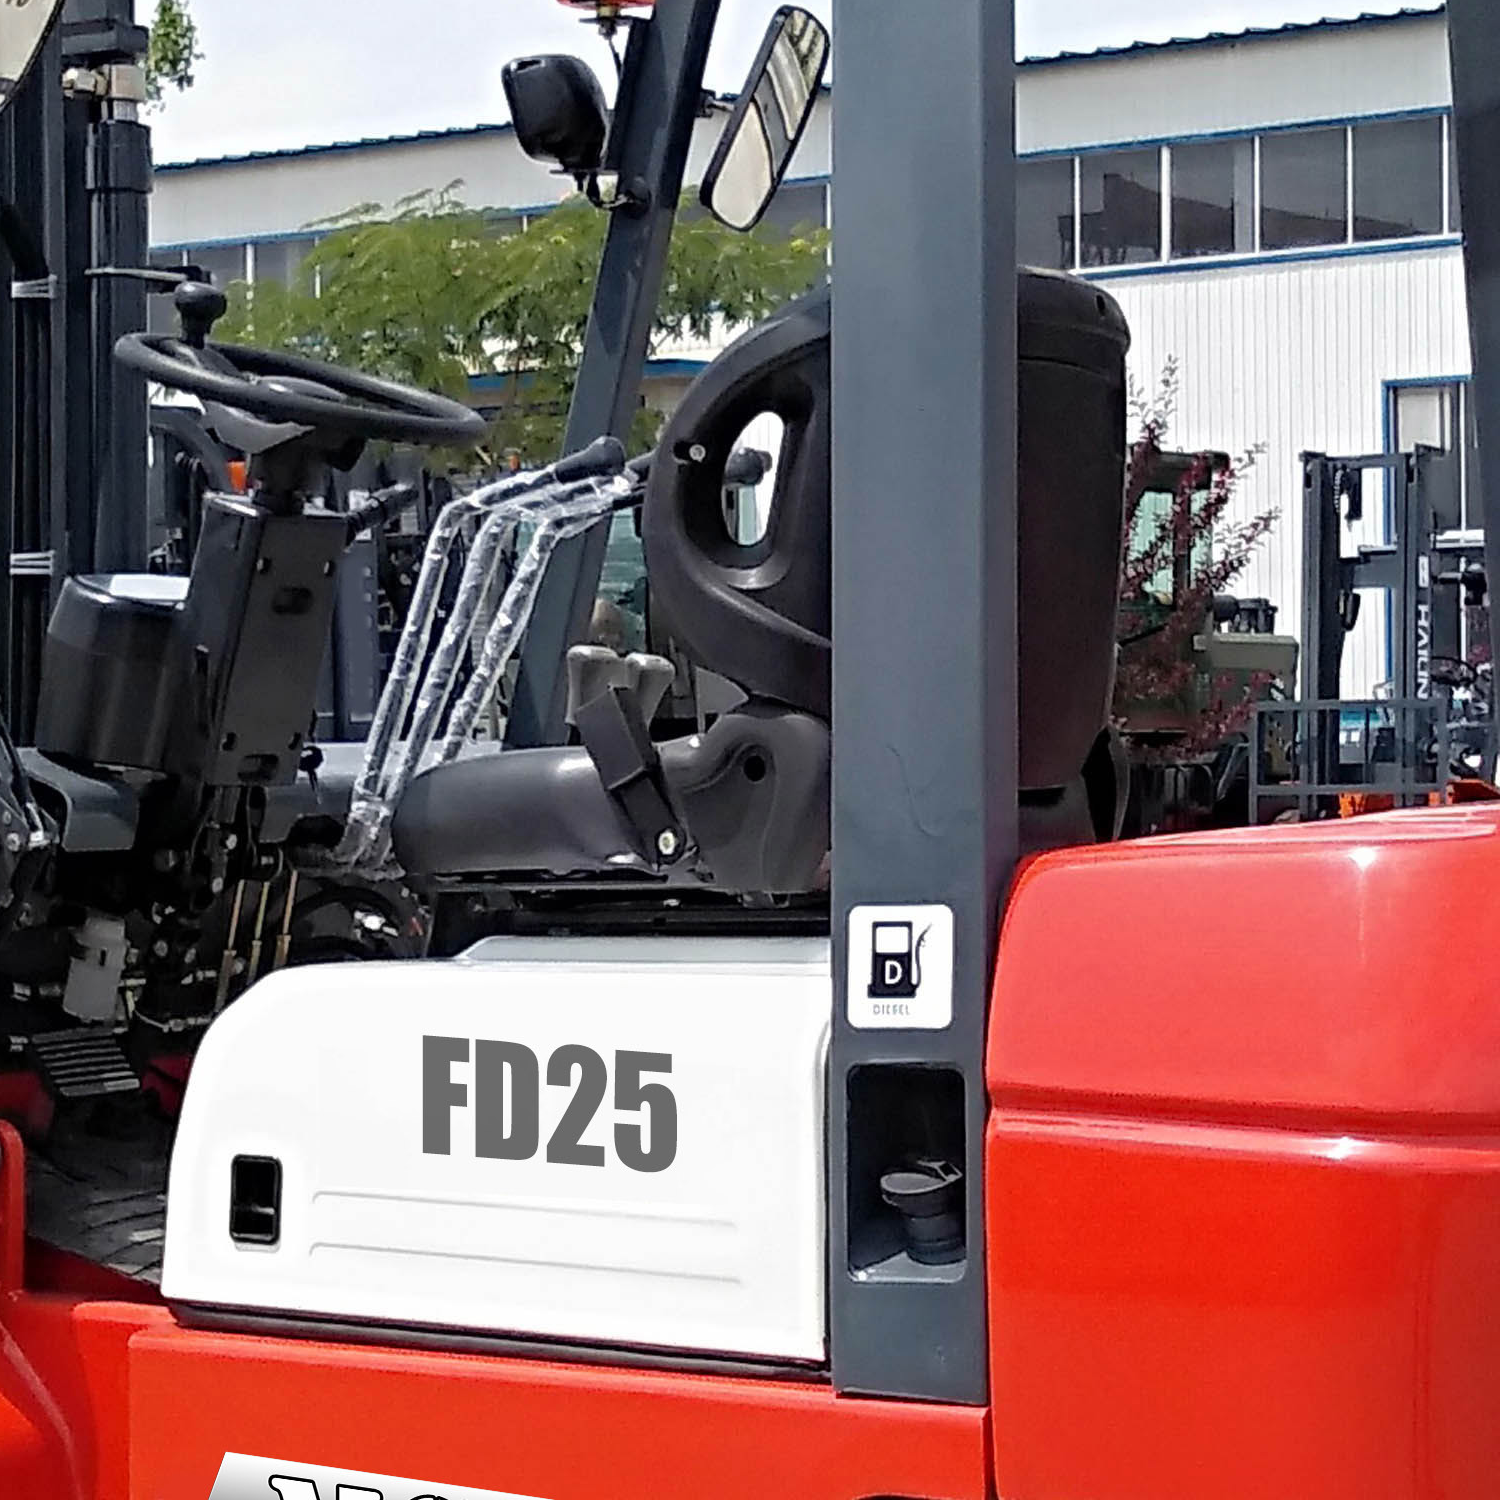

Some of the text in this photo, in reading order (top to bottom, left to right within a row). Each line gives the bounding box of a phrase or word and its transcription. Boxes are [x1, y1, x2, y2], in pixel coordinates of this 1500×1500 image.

[884, 959, 903, 985] D
[872, 1003, 911, 1016] DIESEL
[422, 1034, 678, 1172] FD25
